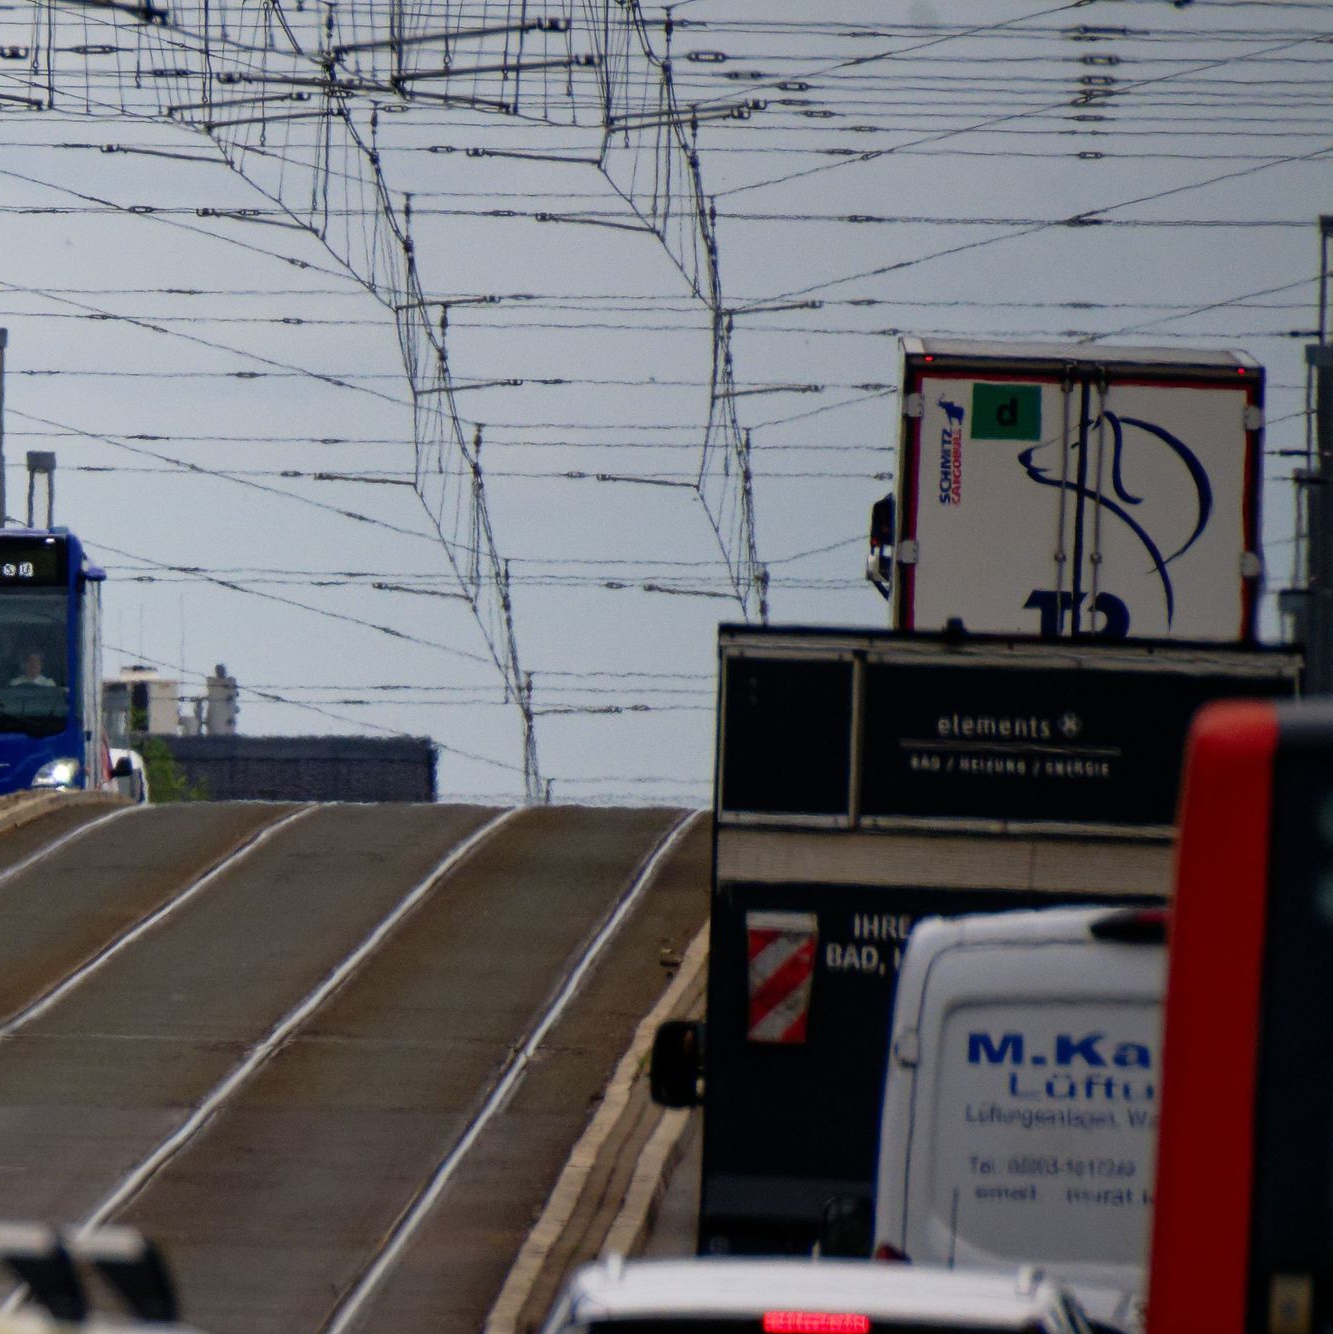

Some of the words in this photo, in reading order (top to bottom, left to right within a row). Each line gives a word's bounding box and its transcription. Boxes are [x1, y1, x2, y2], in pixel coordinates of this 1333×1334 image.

[996, 397, 1019, 428] d
[938, 428, 952, 504] SCHMITZ
[937, 713, 1052, 738] elements
[853, 912, 910, 940] IHRE
[826, 942, 886, 976] BAD,
[967, 1031, 1152, 1070] M.Ka
